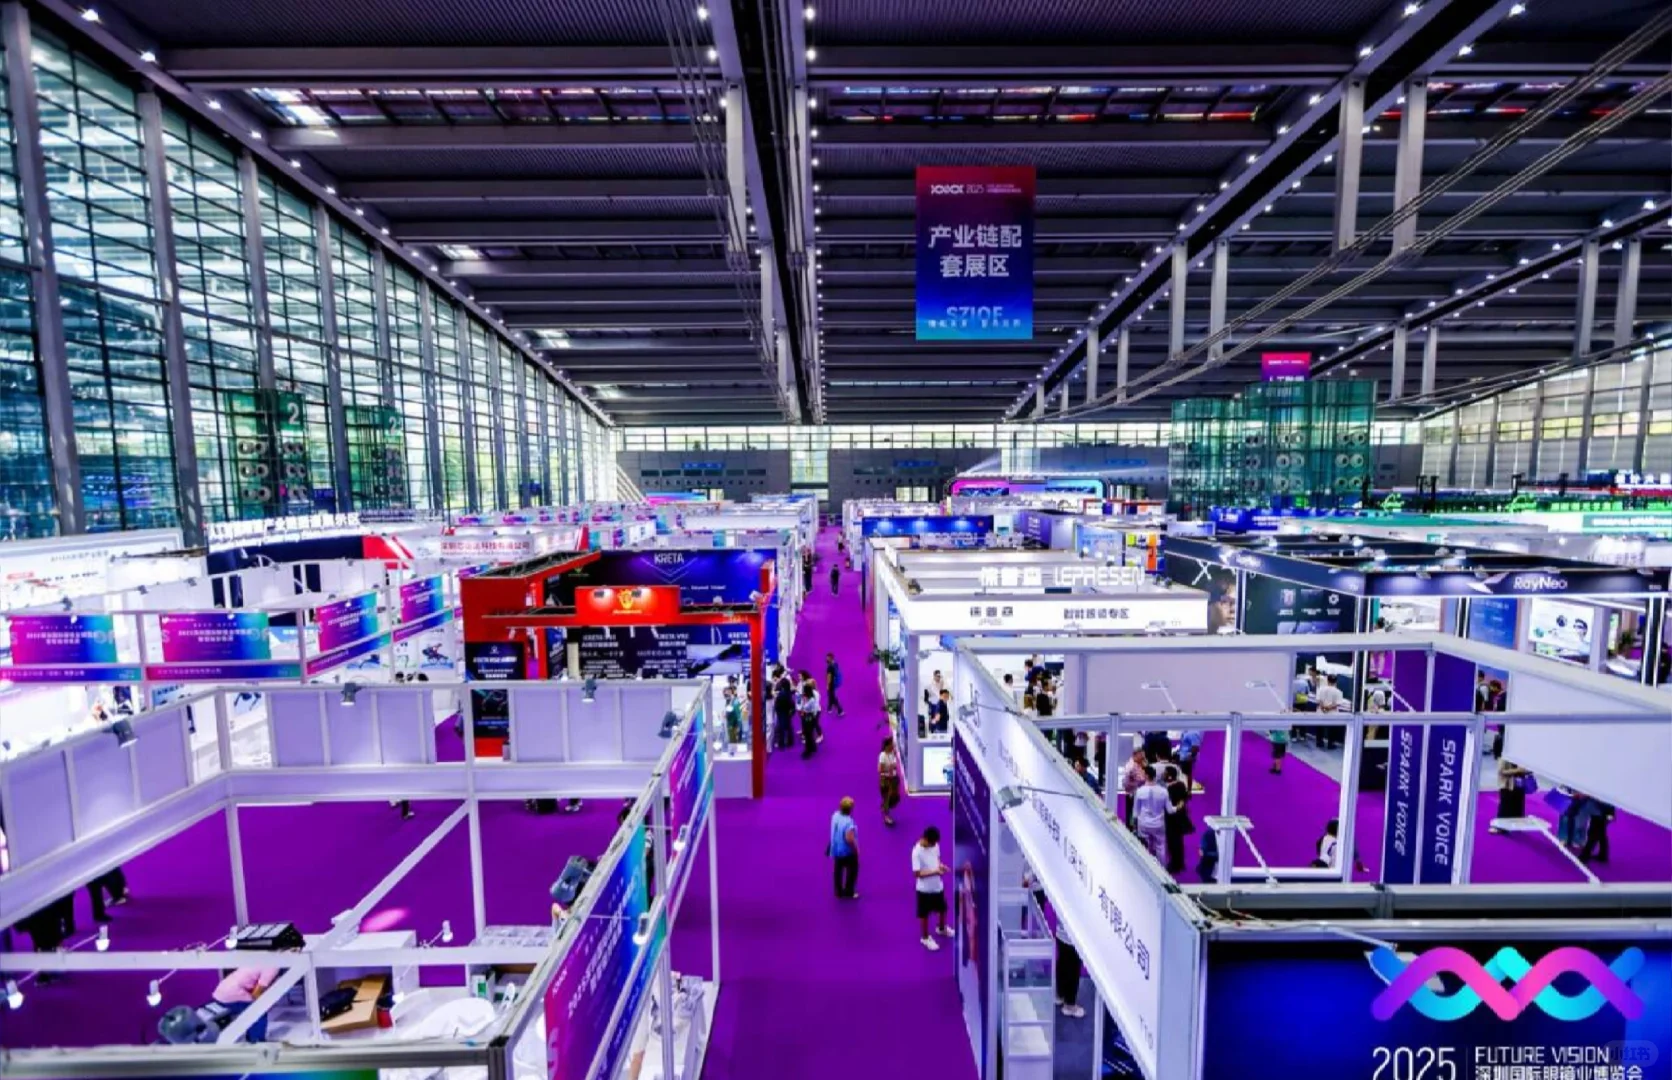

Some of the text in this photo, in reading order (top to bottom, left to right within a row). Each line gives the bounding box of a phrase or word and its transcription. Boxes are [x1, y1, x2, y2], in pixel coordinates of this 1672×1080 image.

[928, 224, 1022, 249] 产业链配
[940, 255, 1010, 278] 套展区
[287, 402, 300, 425] 2
[654, 552, 685, 565] KRETA
[1513, 576, 1568, 592] RayNeo
[1394, 728, 1413, 857] SPARK VOICE
[1434, 738, 1456, 866] SPARK VOICE
[1372, 1046, 1610, 1080] 2025 FUTURE VISION
